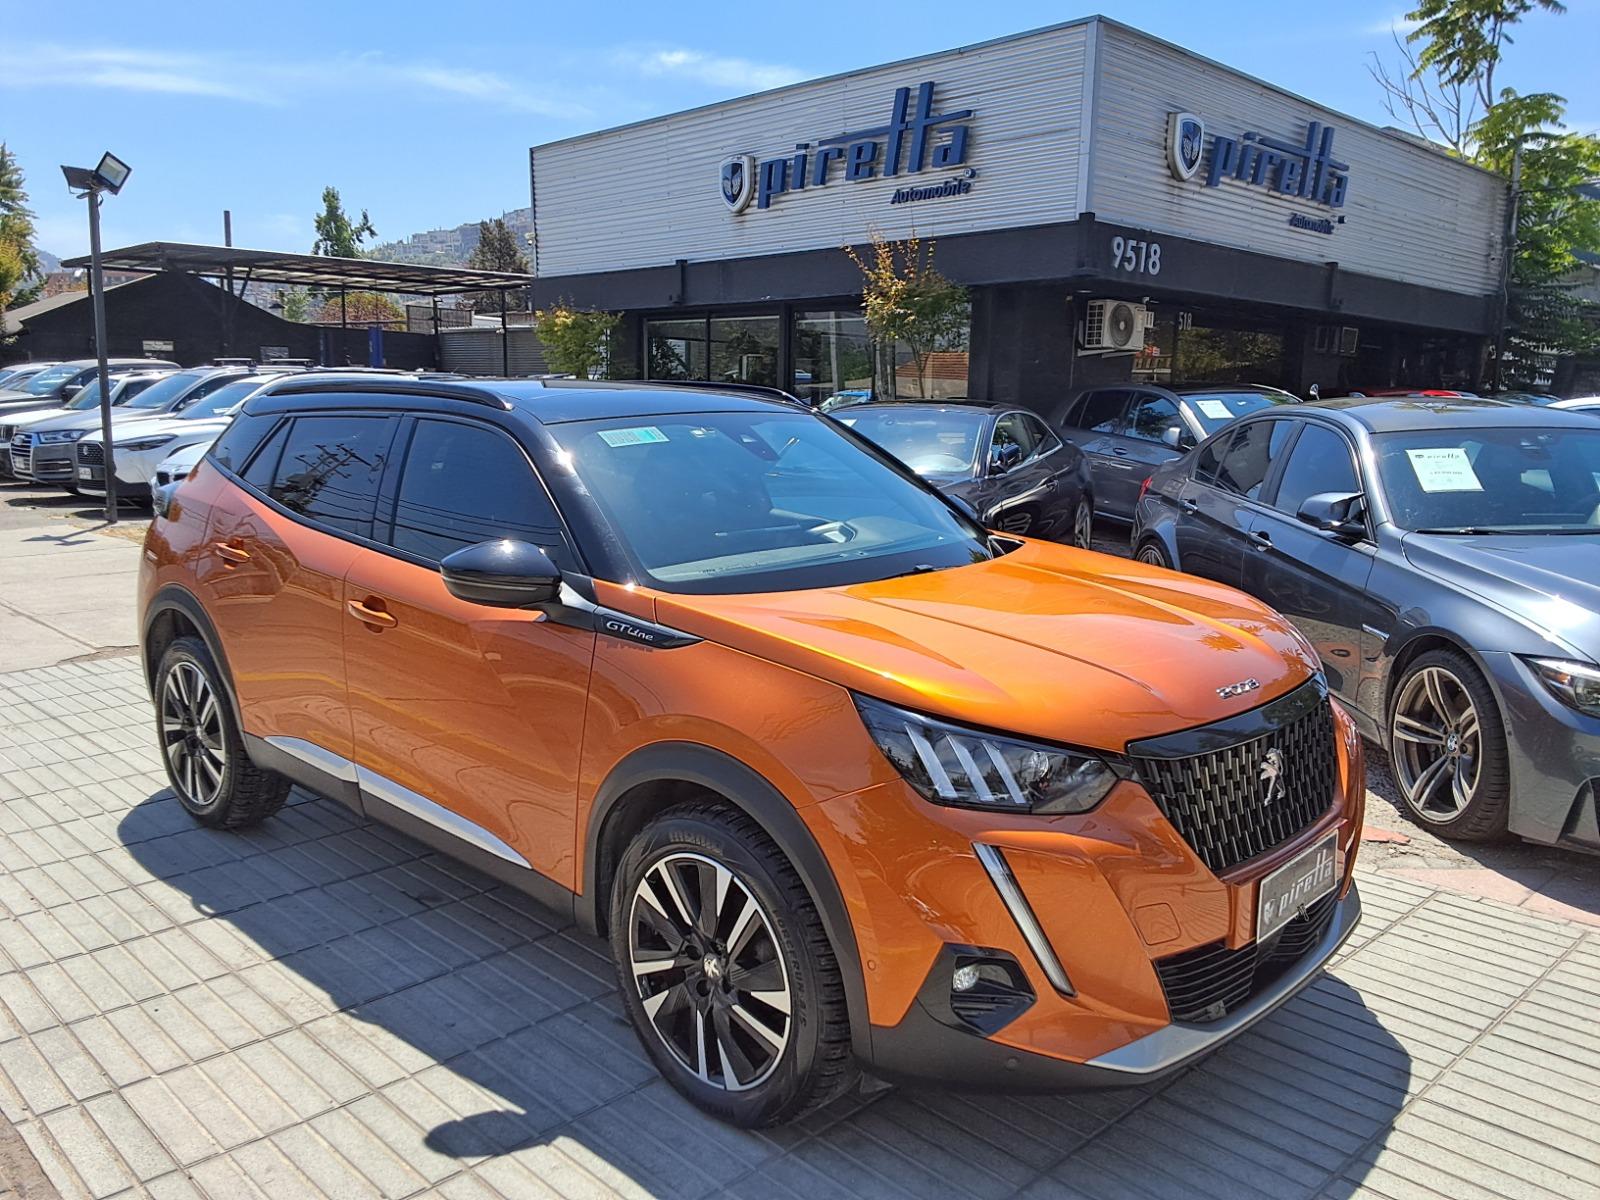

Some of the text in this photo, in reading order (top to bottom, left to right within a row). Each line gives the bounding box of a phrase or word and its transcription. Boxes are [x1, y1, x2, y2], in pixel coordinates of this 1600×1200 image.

[757, 81, 973, 209] piretta
[1206, 121, 1350, 208] piretta
[890, 177, 972, 205] Automobile
[1112, 236, 1161, 276] 9518
[1278, 849, 1335, 917] piretta
